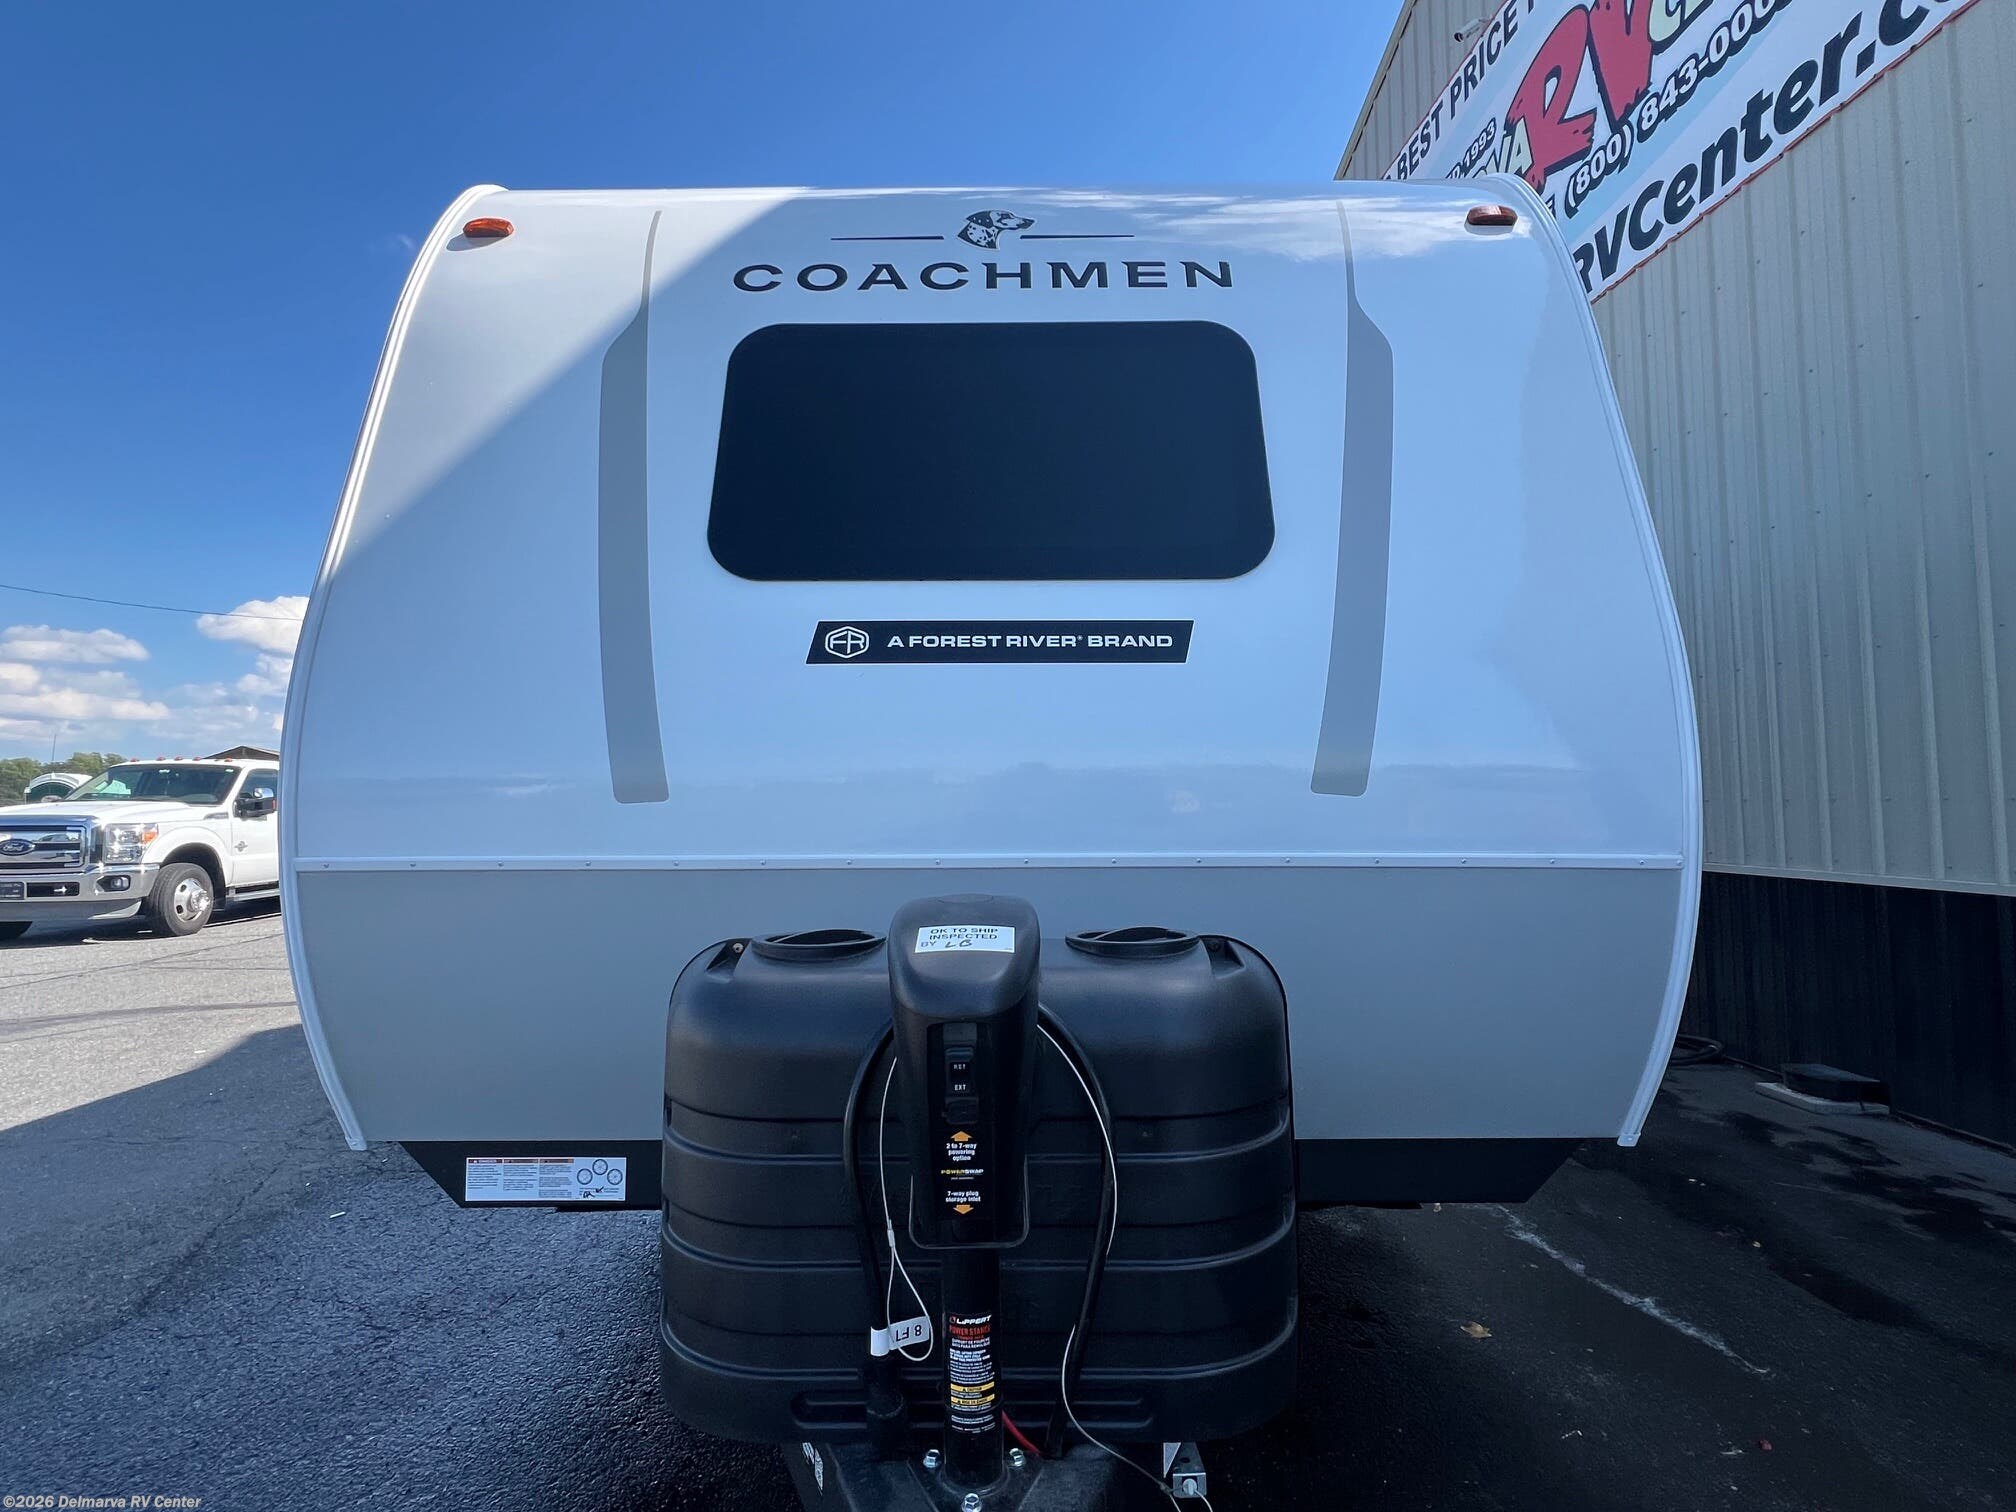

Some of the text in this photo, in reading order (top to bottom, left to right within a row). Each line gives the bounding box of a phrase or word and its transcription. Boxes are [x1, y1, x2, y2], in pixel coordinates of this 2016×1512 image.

[1397, 0, 1519, 180] BEST PRICE
[1463, 119, 1496, 169] 1993
[1567, 121, 1631, 211] (800)
[732, 260, 1234, 293] COACHMEN
[887, 635, 905, 648] A
[908, 635, 1001, 648] FOREST
[1087, 635, 1173, 648] BRAND
[914, 1324, 922, 1337] 8
